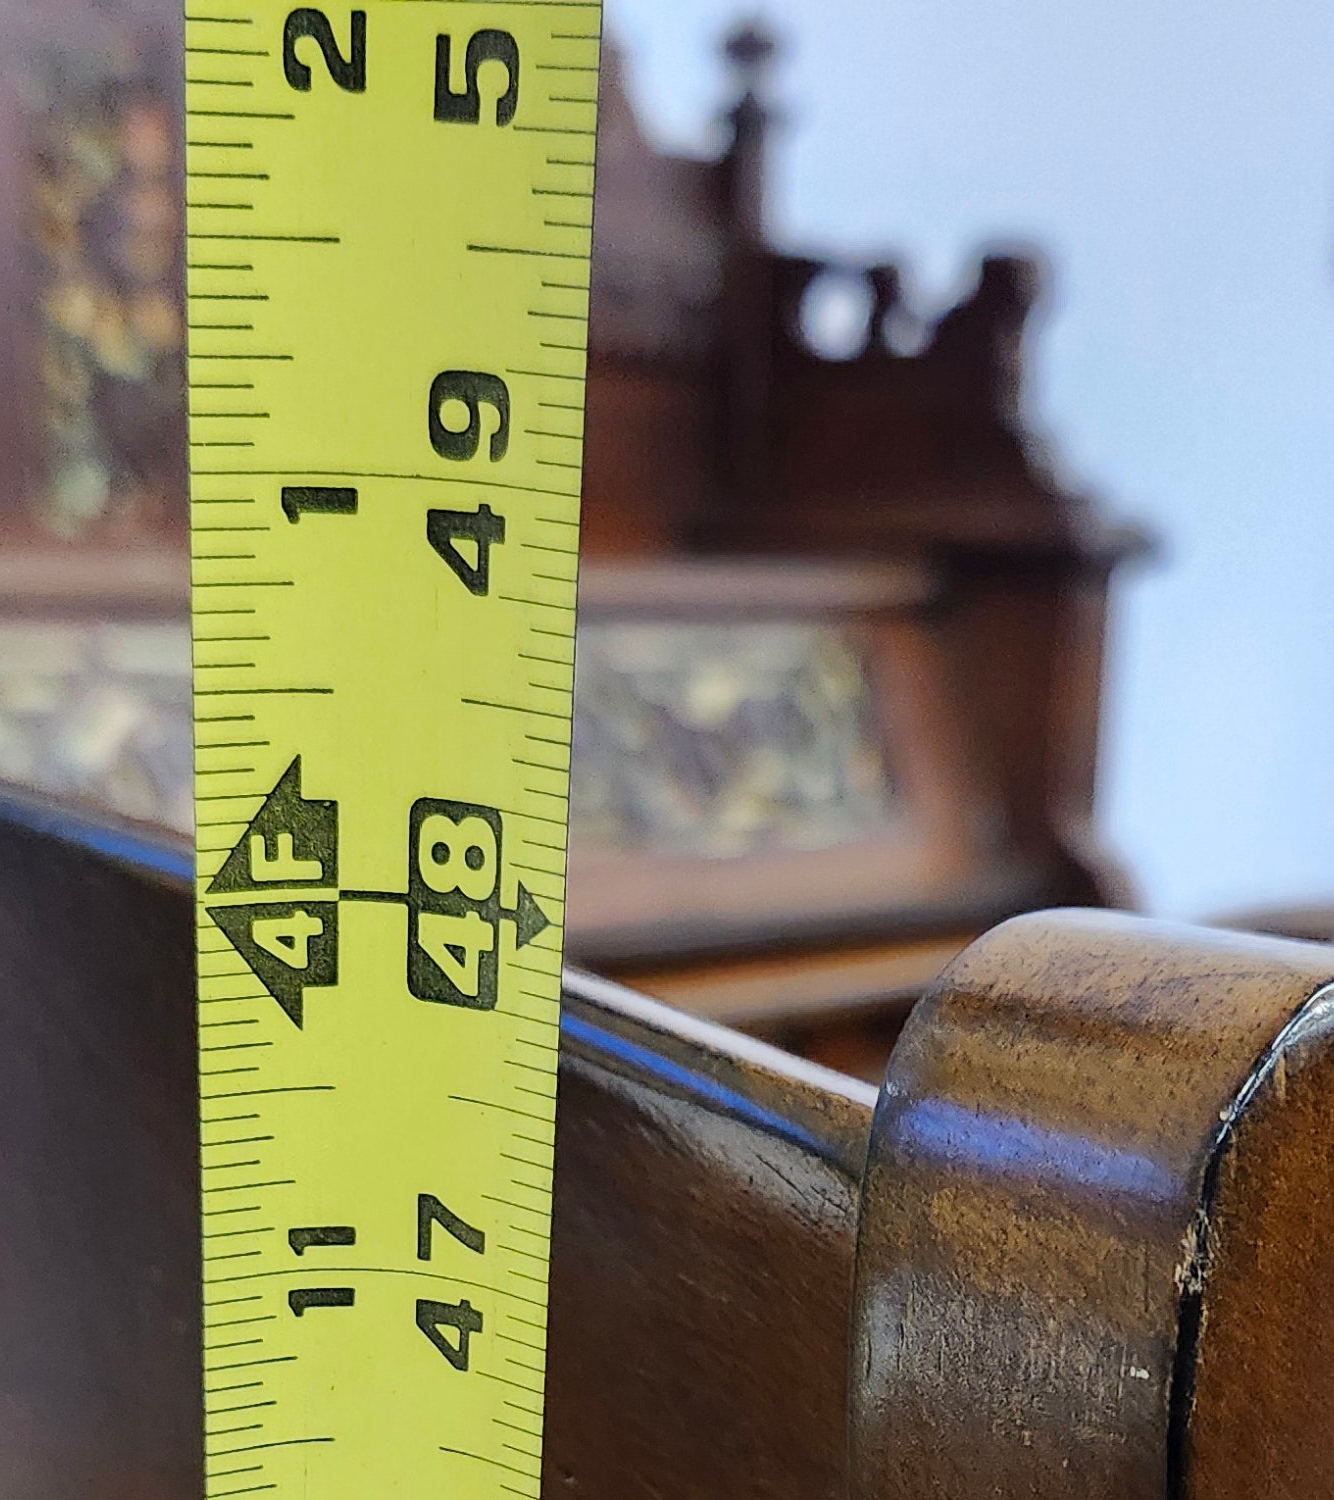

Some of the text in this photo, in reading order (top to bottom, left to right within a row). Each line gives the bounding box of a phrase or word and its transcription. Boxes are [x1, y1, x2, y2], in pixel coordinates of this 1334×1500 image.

[282, 7, 367, 93] 2
[433, 28, 519, 127] 5
[281, 485, 358, 524] 1
[427, 369, 510, 597] 49
[249, 831, 324, 970] 4F
[417, 814, 496, 997] 48
[288, 1225, 357, 1317] 11
[415, 1193, 485, 1371] 47
